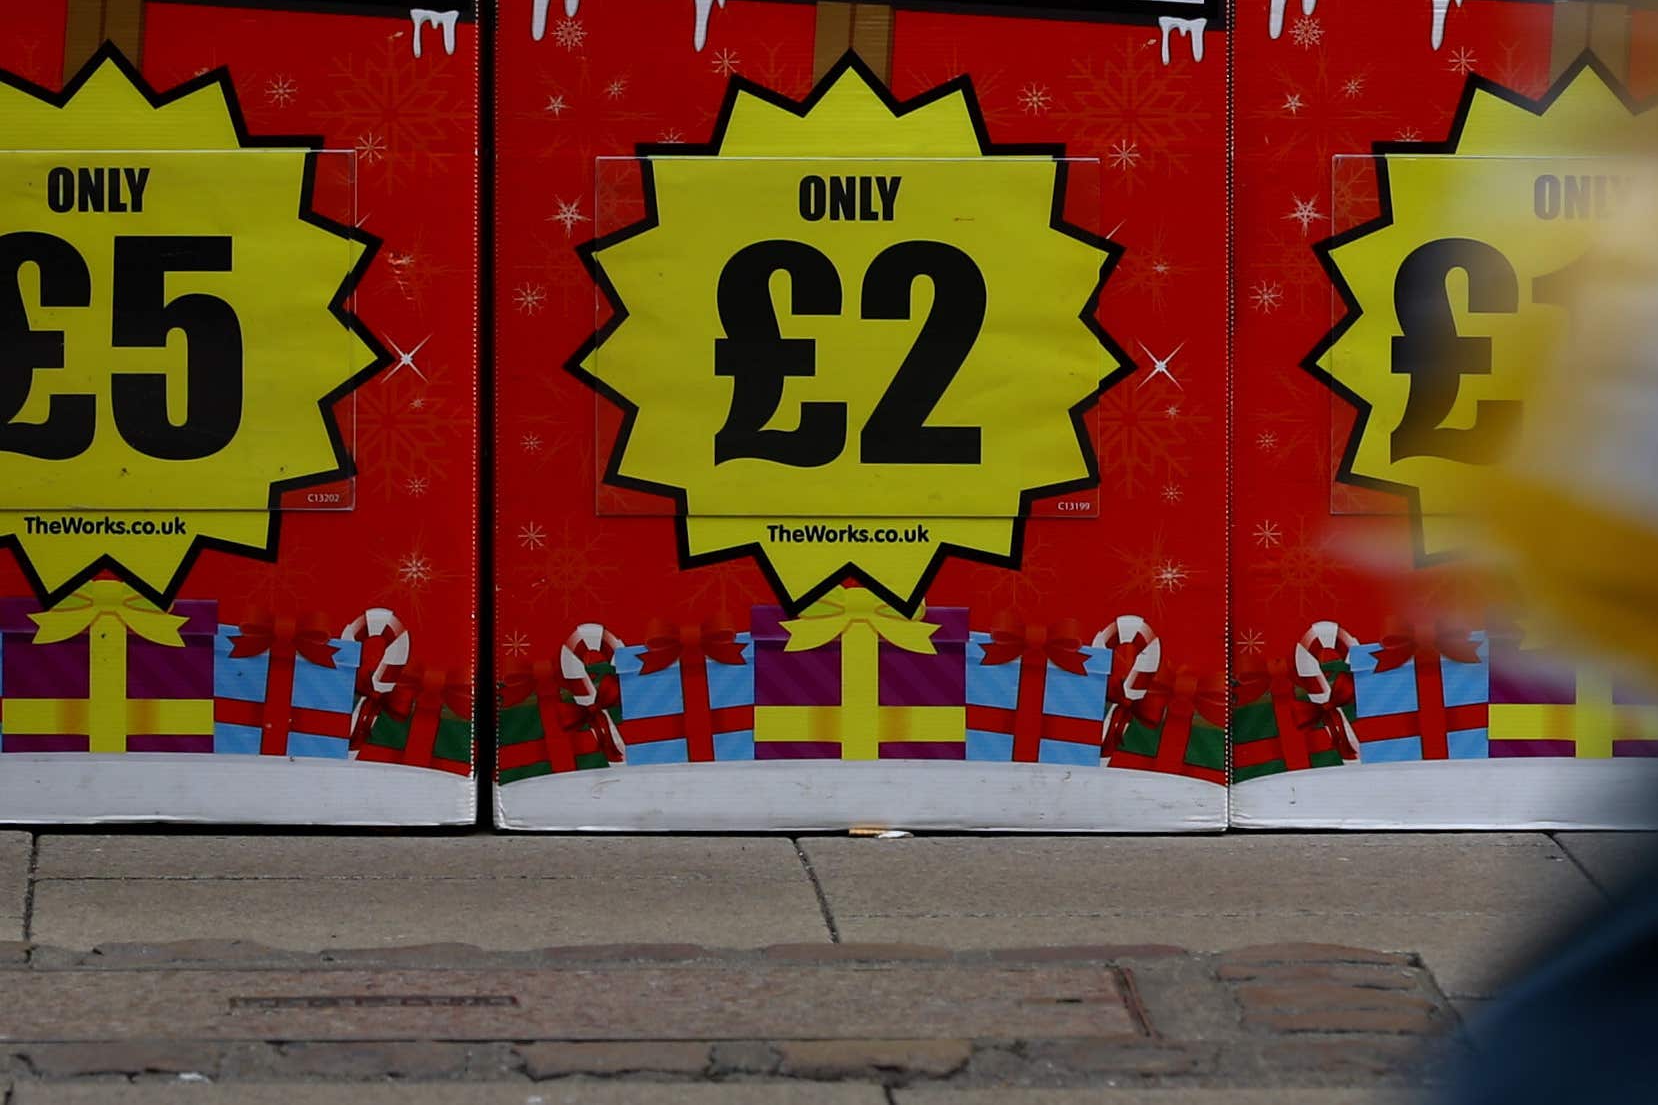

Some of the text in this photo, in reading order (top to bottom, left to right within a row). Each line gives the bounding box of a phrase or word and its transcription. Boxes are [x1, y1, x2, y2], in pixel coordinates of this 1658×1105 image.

[47, 166, 150, 213] ONLY
[798, 174, 902, 222] ONLY
[0, 231, 243, 461] £5
[714, 239, 987, 468] £2
[307, 493, 341, 503] C13202
[1057, 501, 1091, 511] C13199
[24, 517, 186, 536] TheWorks.co.uk
[767, 524, 930, 543] TheWorks.co.uk
